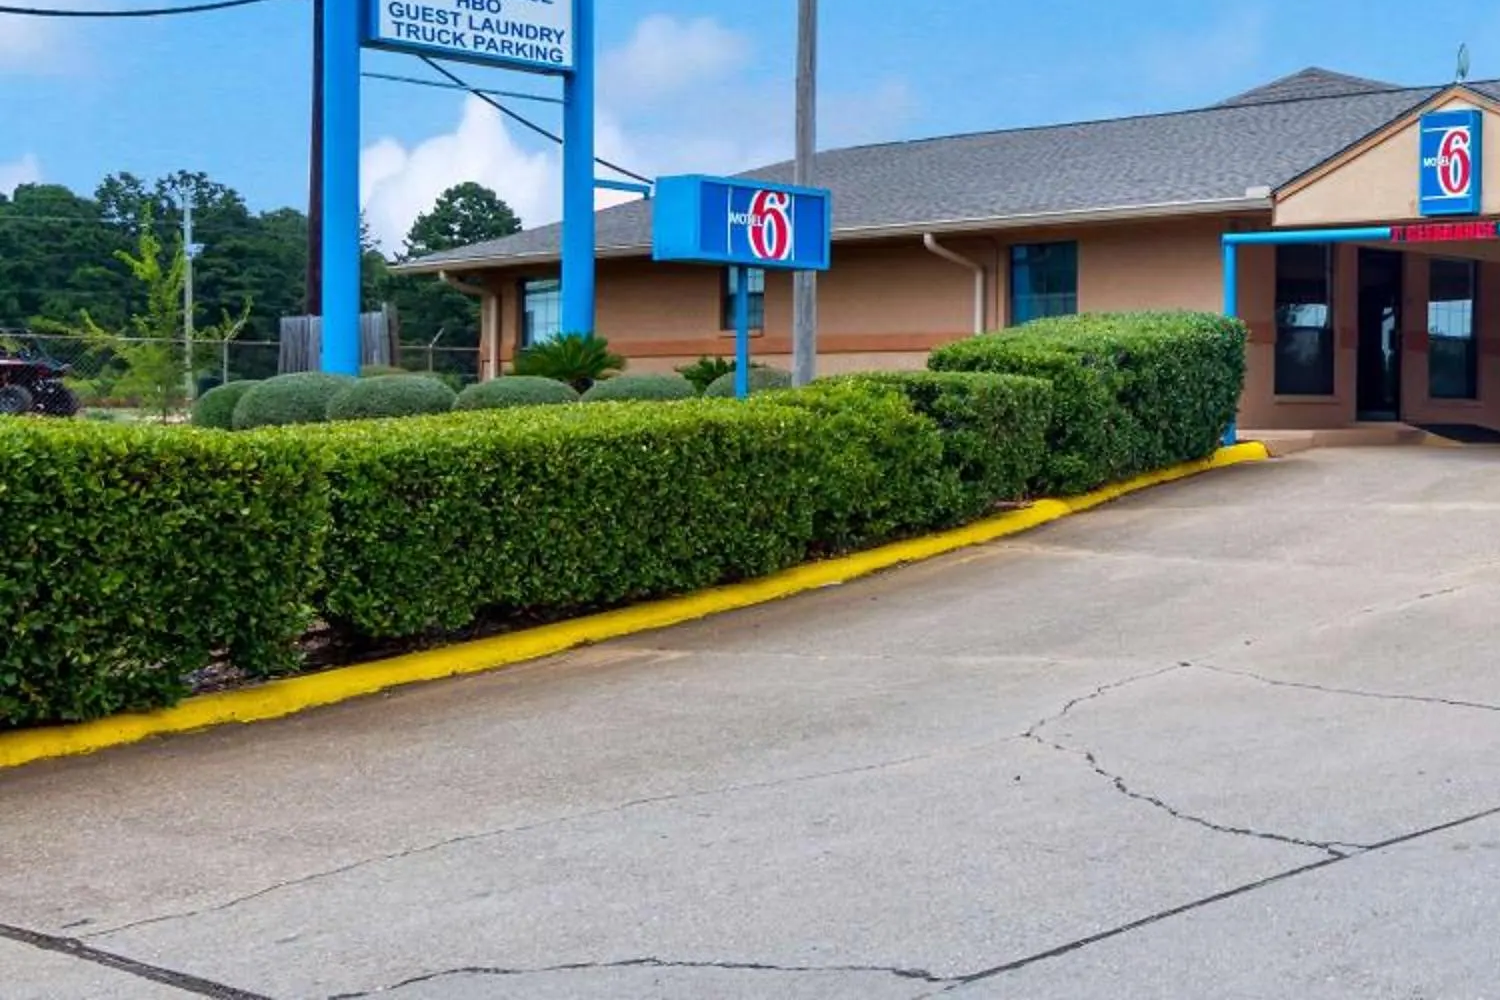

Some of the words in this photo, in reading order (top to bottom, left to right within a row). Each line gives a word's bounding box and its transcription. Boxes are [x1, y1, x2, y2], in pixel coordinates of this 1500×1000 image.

[388, 1, 462, 27] GUEST
[468, 15, 565, 45] LAUNDRY
[392, 20, 466, 48] TRUCK
[473, 35, 564, 63] PARKING
[1438, 127, 1472, 197] 6
[730, 211, 764, 227] MOTEL
[748, 189, 791, 260] 6
